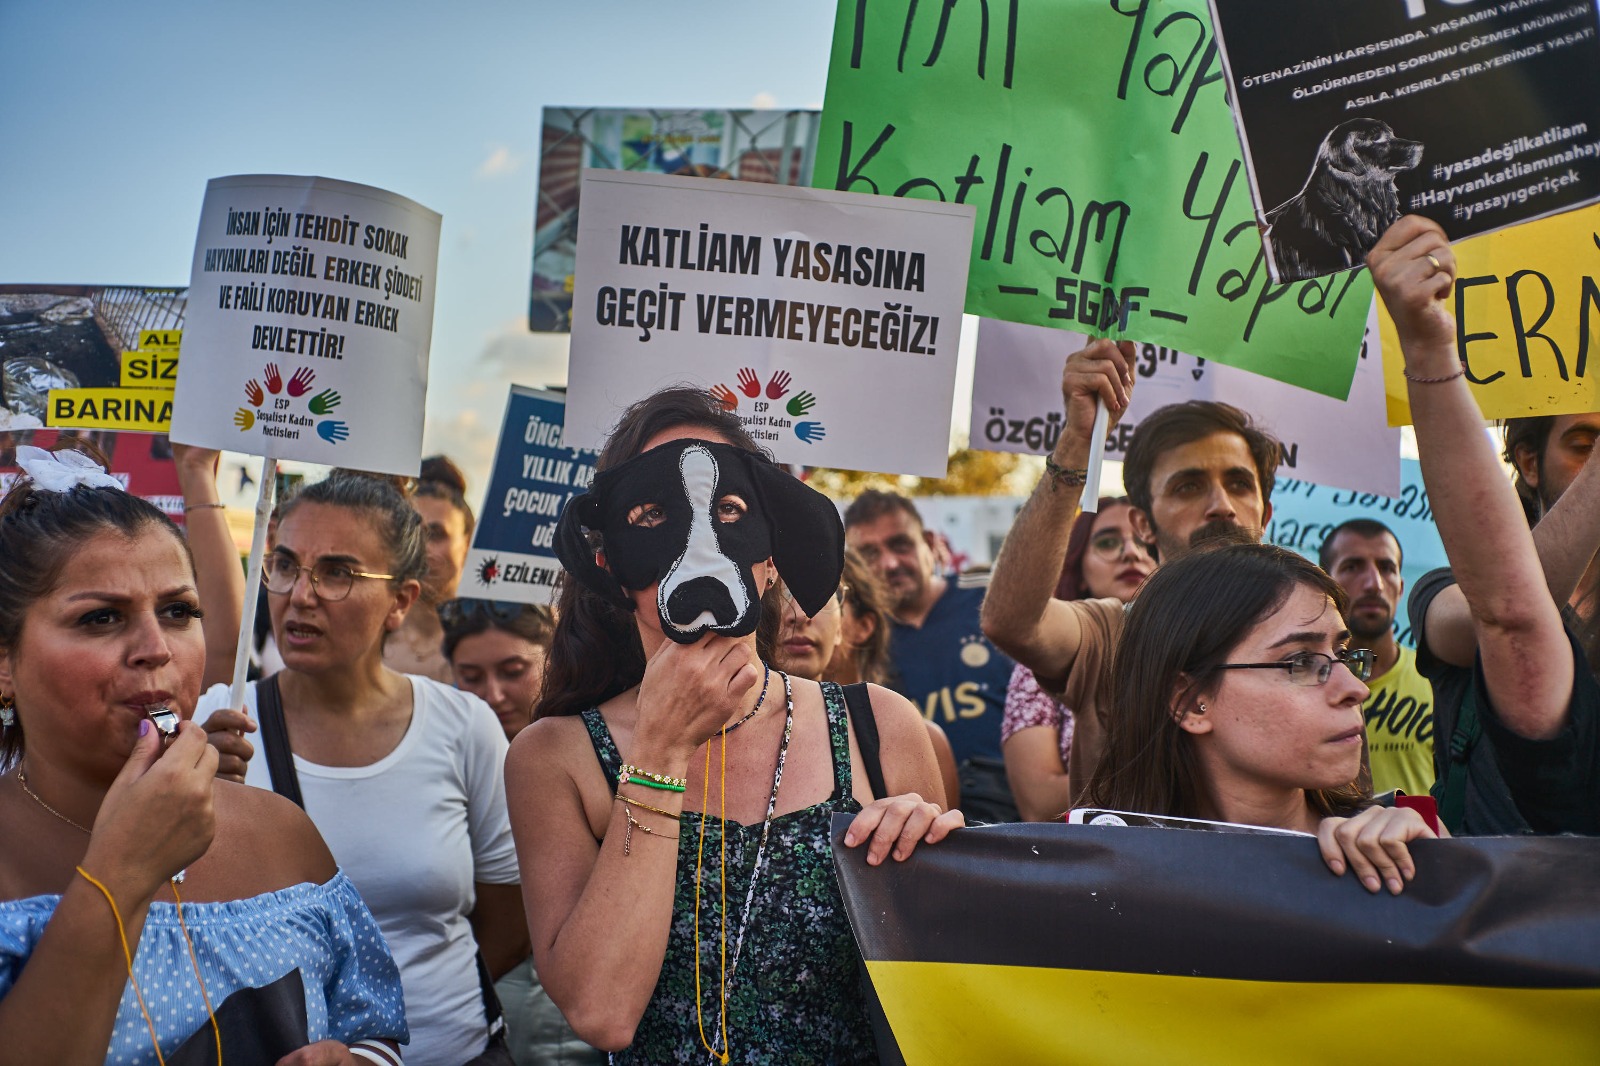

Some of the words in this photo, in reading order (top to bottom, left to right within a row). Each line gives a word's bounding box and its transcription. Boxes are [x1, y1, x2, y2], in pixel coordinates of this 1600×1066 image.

[1242, 55, 1333, 89] ÖTENAZİNİN
[1431, 7, 1498, 35] YAŞAMIN
[1292, 63, 1396, 100] ÖLDÜRMEDEN
[1398, 45, 1457, 72] SORUNU
[1460, 26, 1521, 53] ÇÖZMEK
[1433, 122, 1588, 180] #yasadeğilkatliam
[1454, 168, 1581, 220] #yasayıgeriçek
[226, 206, 260, 236] İNSAN
[262, 206, 292, 244] İÇİN
[294, 212, 359, 246] TEHDİT
[363, 224, 409, 260] SOKAK
[204, 248, 269, 274] HAYVANLARI
[271, 245, 317, 279] DEĞİL
[324, 255, 382, 290] ERKEK
[383, 265, 423, 302] ŞİDDETİ
[619, 223, 762, 275] KATLİAM
[773, 238, 925, 292] YASASINA
[219, 285, 233, 309] VE
[233, 281, 266, 312] FAİLİ
[267, 288, 350, 322] KORUYAN
[354, 299, 399, 333] ERKEK
[596, 282, 686, 342] GEÇİT
[697, 293, 939, 356] VERMEYECEĞİZ!
[252, 325, 345, 360] DEVLETTİR!
[256, 409, 287, 423] Sosyalist
[288, 414, 314, 427] Kadın
[274, 398, 290, 410] ESP
[754, 401, 769, 412] ESP
[769, 416, 791, 428] Kadın
[262, 425, 300, 440] Meclisleri
[522, 454, 573, 486] YILLIK
[503, 487, 561, 517] ÇOCUK
[911, 681, 986, 723] VIS
